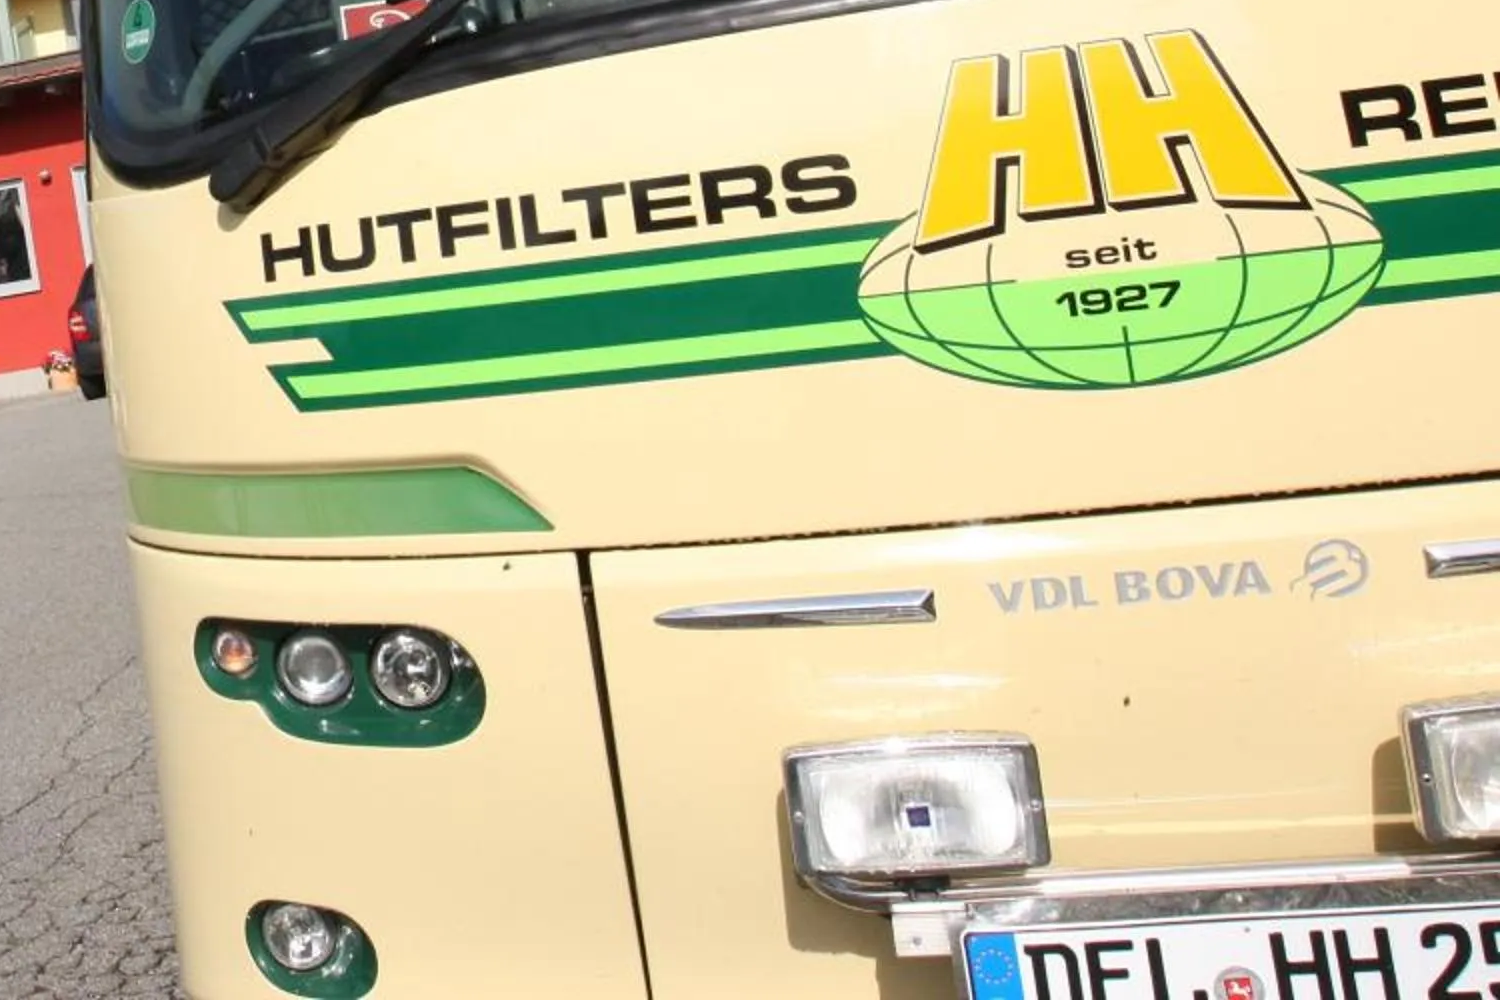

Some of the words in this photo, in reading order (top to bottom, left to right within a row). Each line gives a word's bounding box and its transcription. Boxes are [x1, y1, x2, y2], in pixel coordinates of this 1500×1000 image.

[914, 28, 1313, 255] HH
[1340, 71, 1500, 148] RE
[260, 153, 857, 283] HUTFILTERS
[1064, 237, 1157, 268] seit
[1055, 280, 1181, 318] 1927
[988, 575, 1098, 614] VDL
[1113, 560, 1272, 605] BOVA
[1268, 926, 1400, 1000] HH
